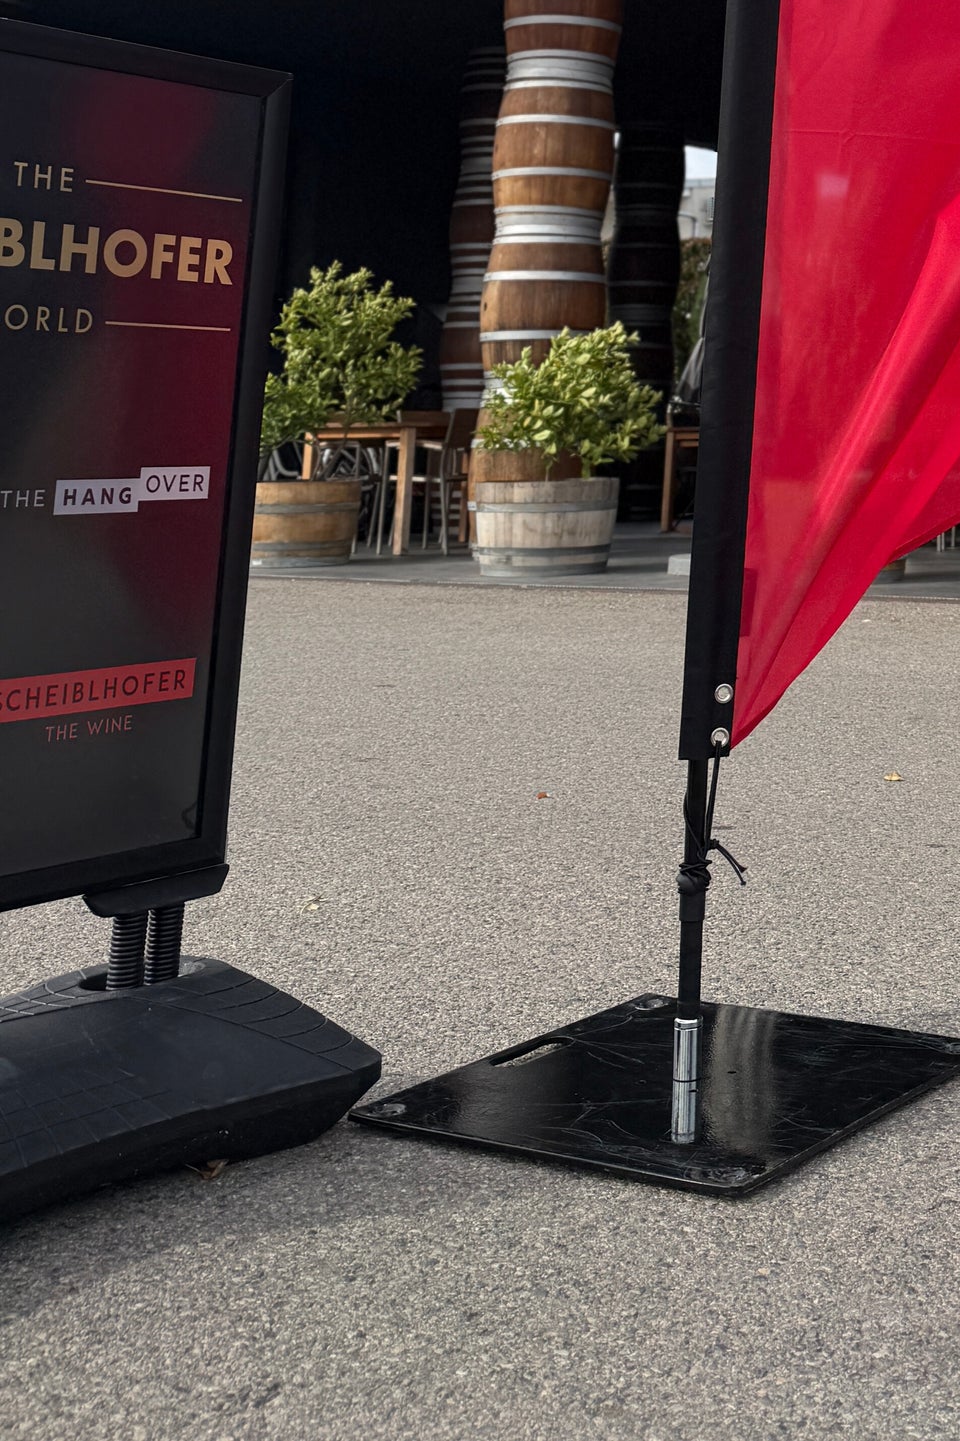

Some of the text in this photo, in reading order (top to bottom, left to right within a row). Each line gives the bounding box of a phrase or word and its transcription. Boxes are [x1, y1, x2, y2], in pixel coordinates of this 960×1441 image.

[14, 161, 74, 193] THE
[4, 304, 93, 333] ORLD
[0, 489, 46, 508] THE
[45, 714, 133, 743] THE WINE
